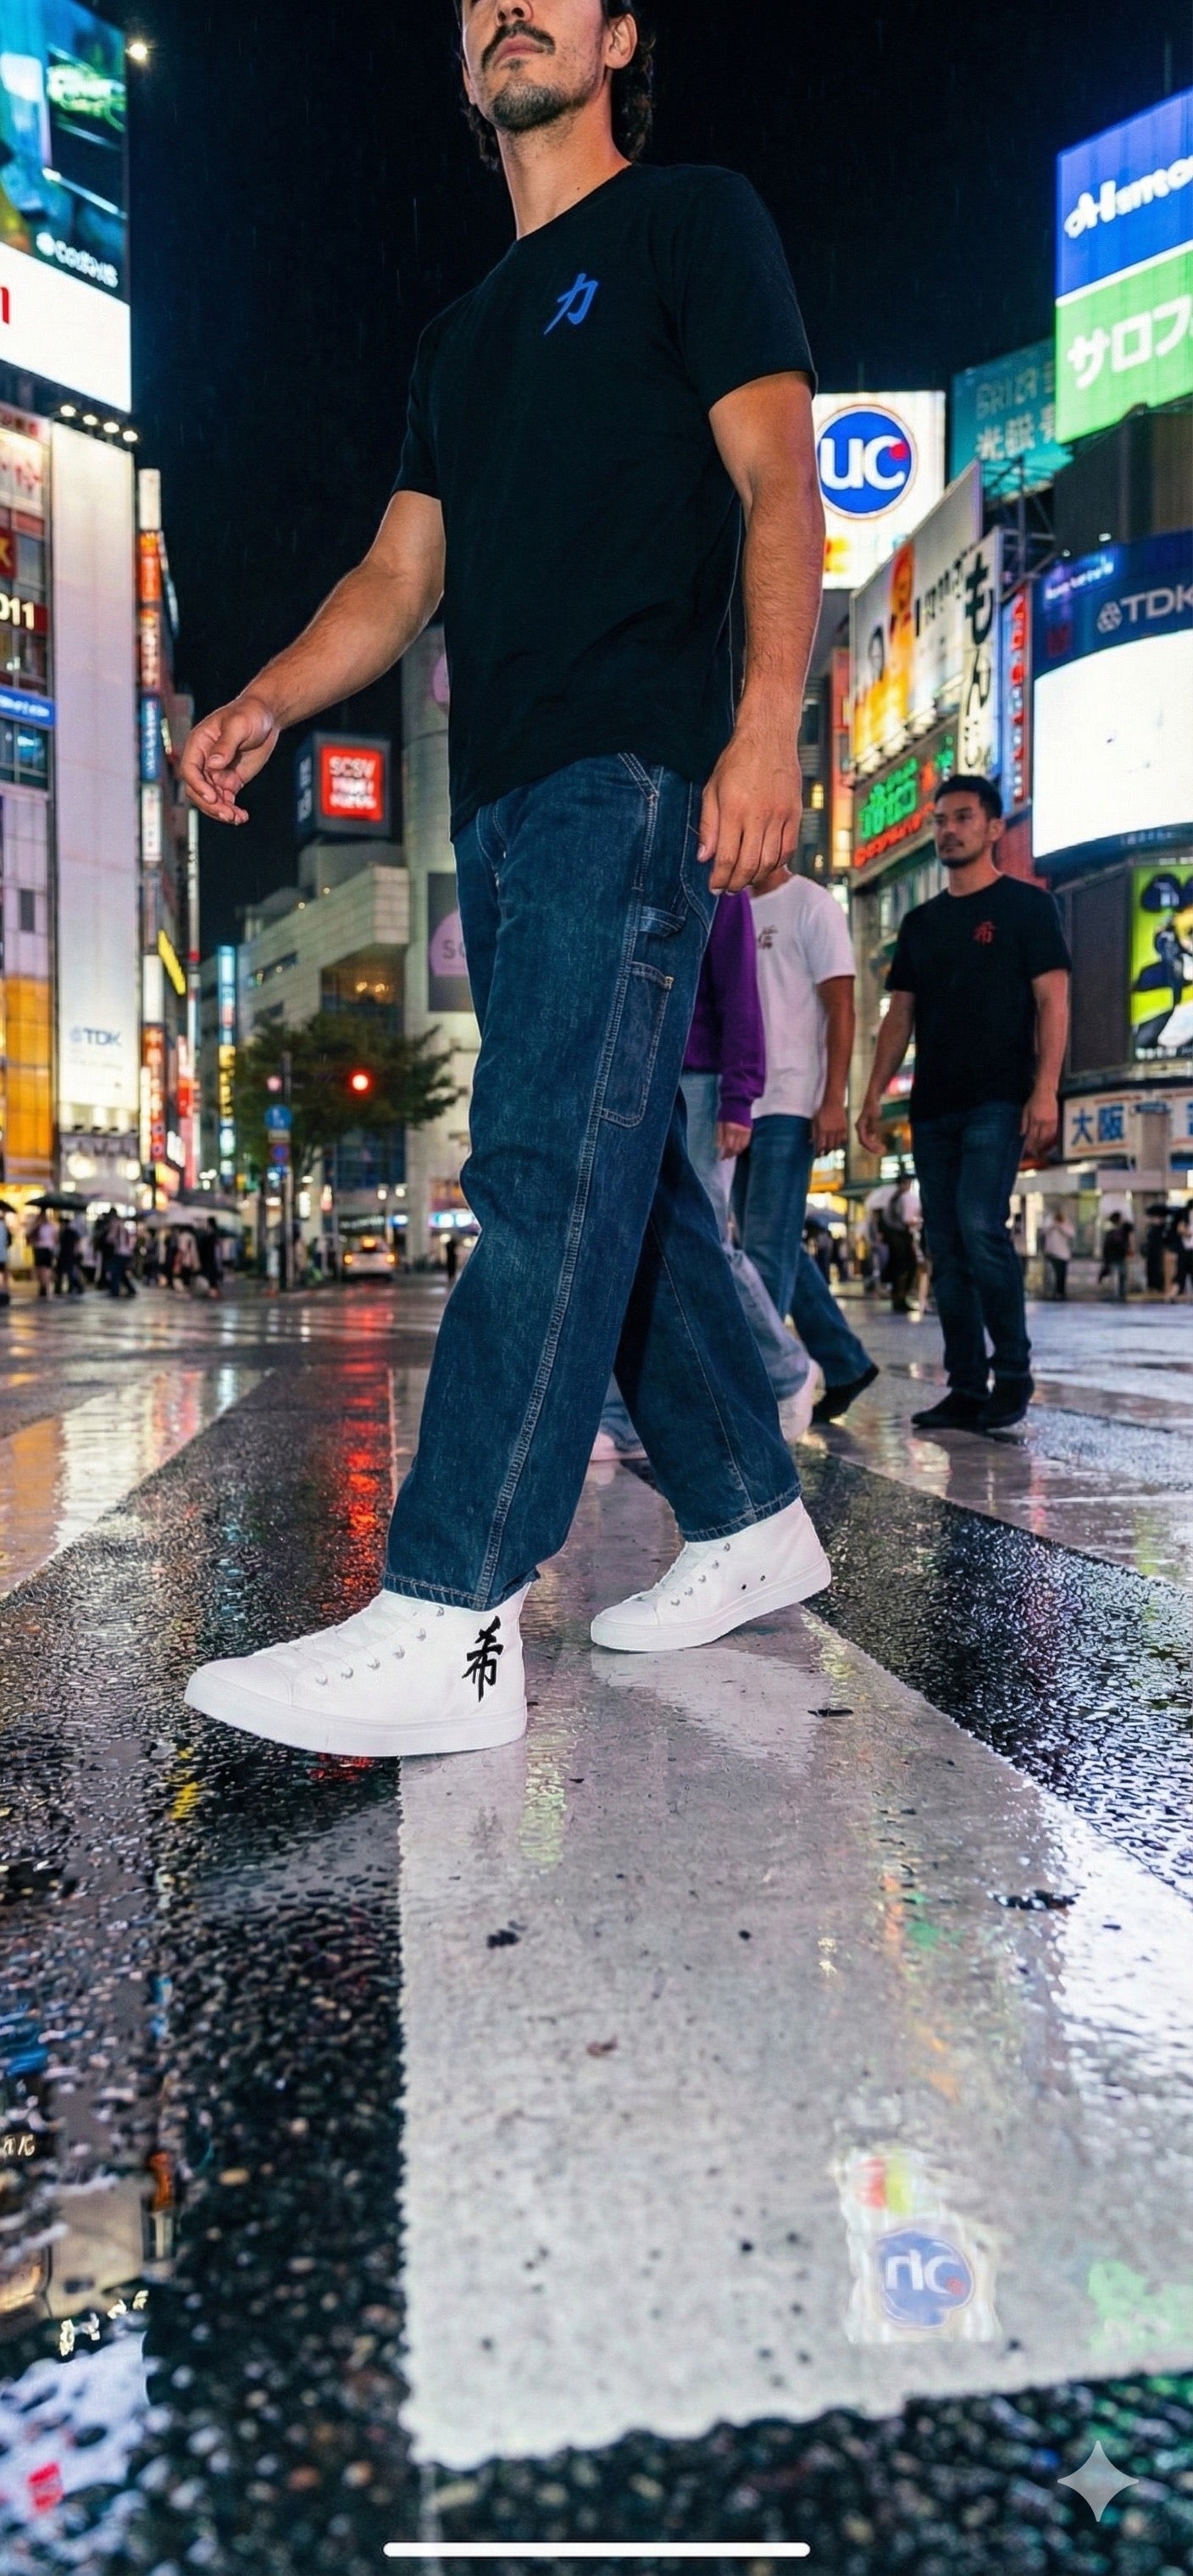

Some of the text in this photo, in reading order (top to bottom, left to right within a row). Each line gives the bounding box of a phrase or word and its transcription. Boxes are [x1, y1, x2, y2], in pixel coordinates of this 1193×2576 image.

[543, 273, 598, 336] 力
[1067, 293, 1193, 391] サロフ
[84, 1027, 121, 1046] TDK
[461, 1615, 504, 1702] 希
